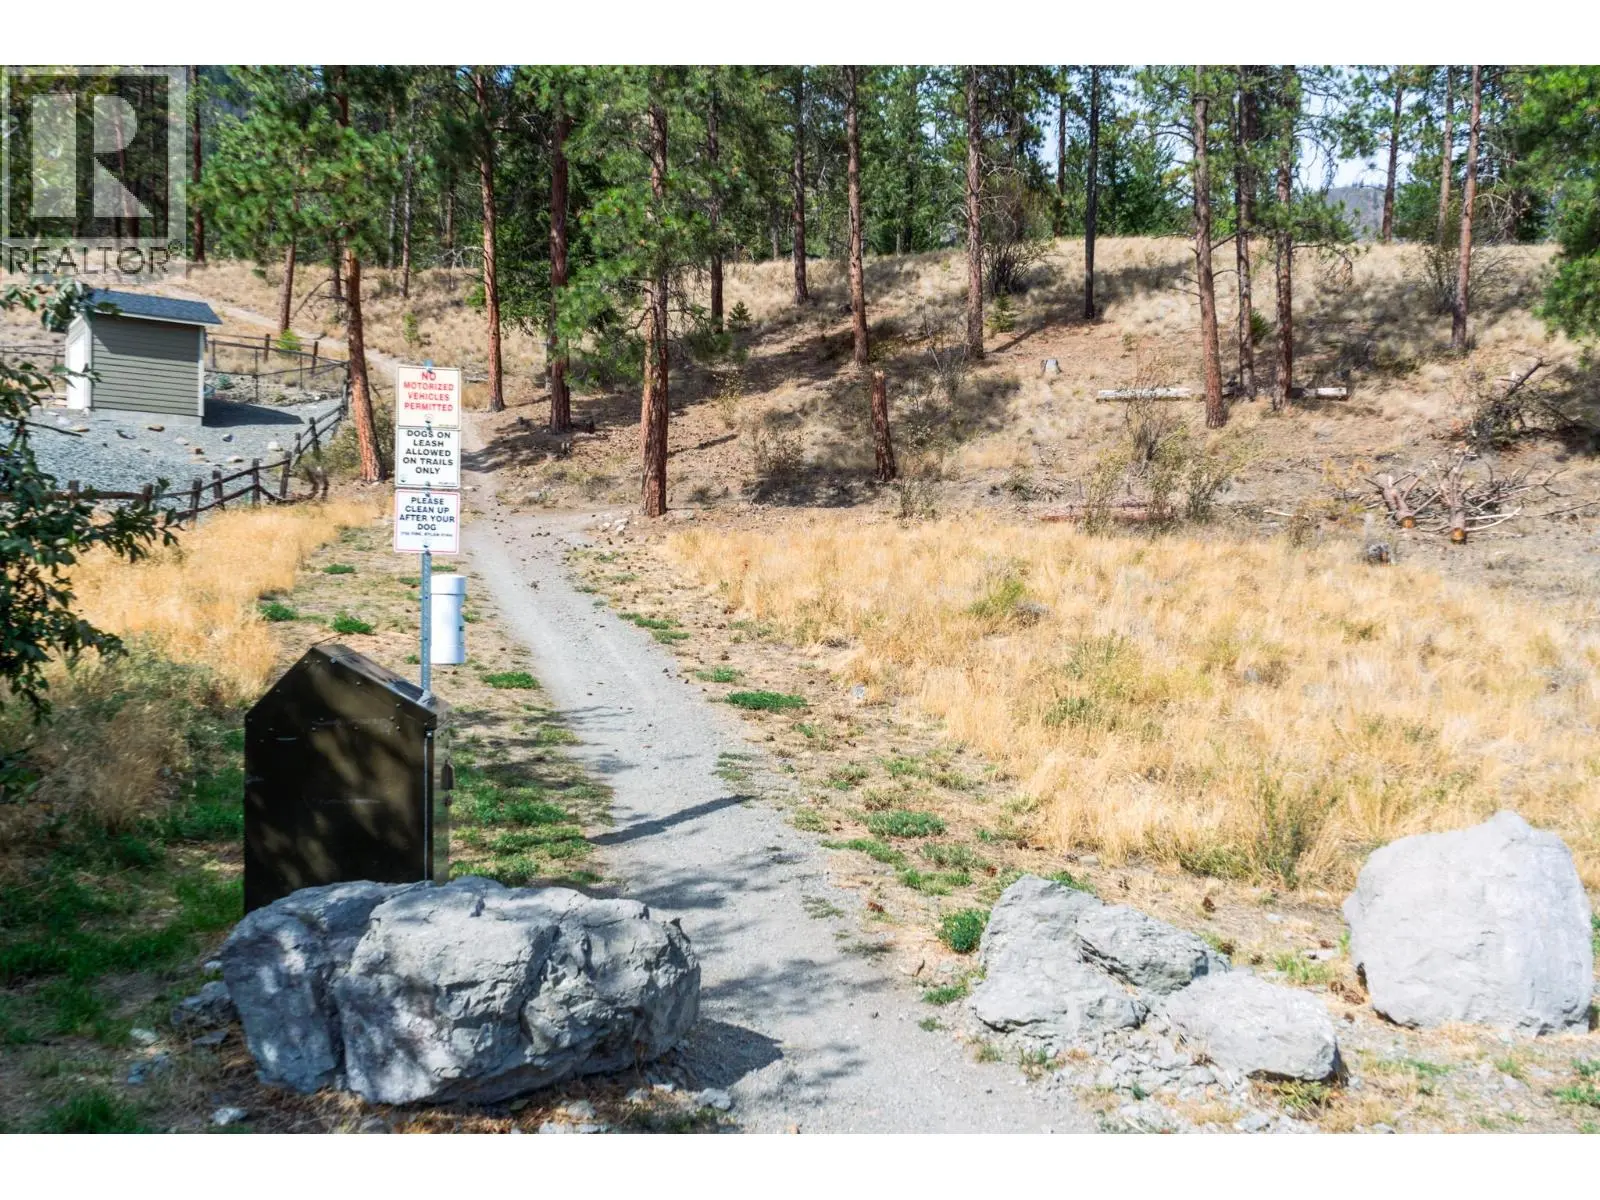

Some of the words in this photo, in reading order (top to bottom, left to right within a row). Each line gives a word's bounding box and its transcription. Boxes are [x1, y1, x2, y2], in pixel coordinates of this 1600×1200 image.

[422, 372, 436, 380] NO
[404, 382, 454, 390] MOTORIZED
[408, 392, 450, 401] VEHICLES
[404, 402, 453, 412] PERMITTED
[406, 448, 451, 456] ALLOWED
[420, 458, 454, 466] TRAILS
[411, 497, 444, 505] PLEASE
